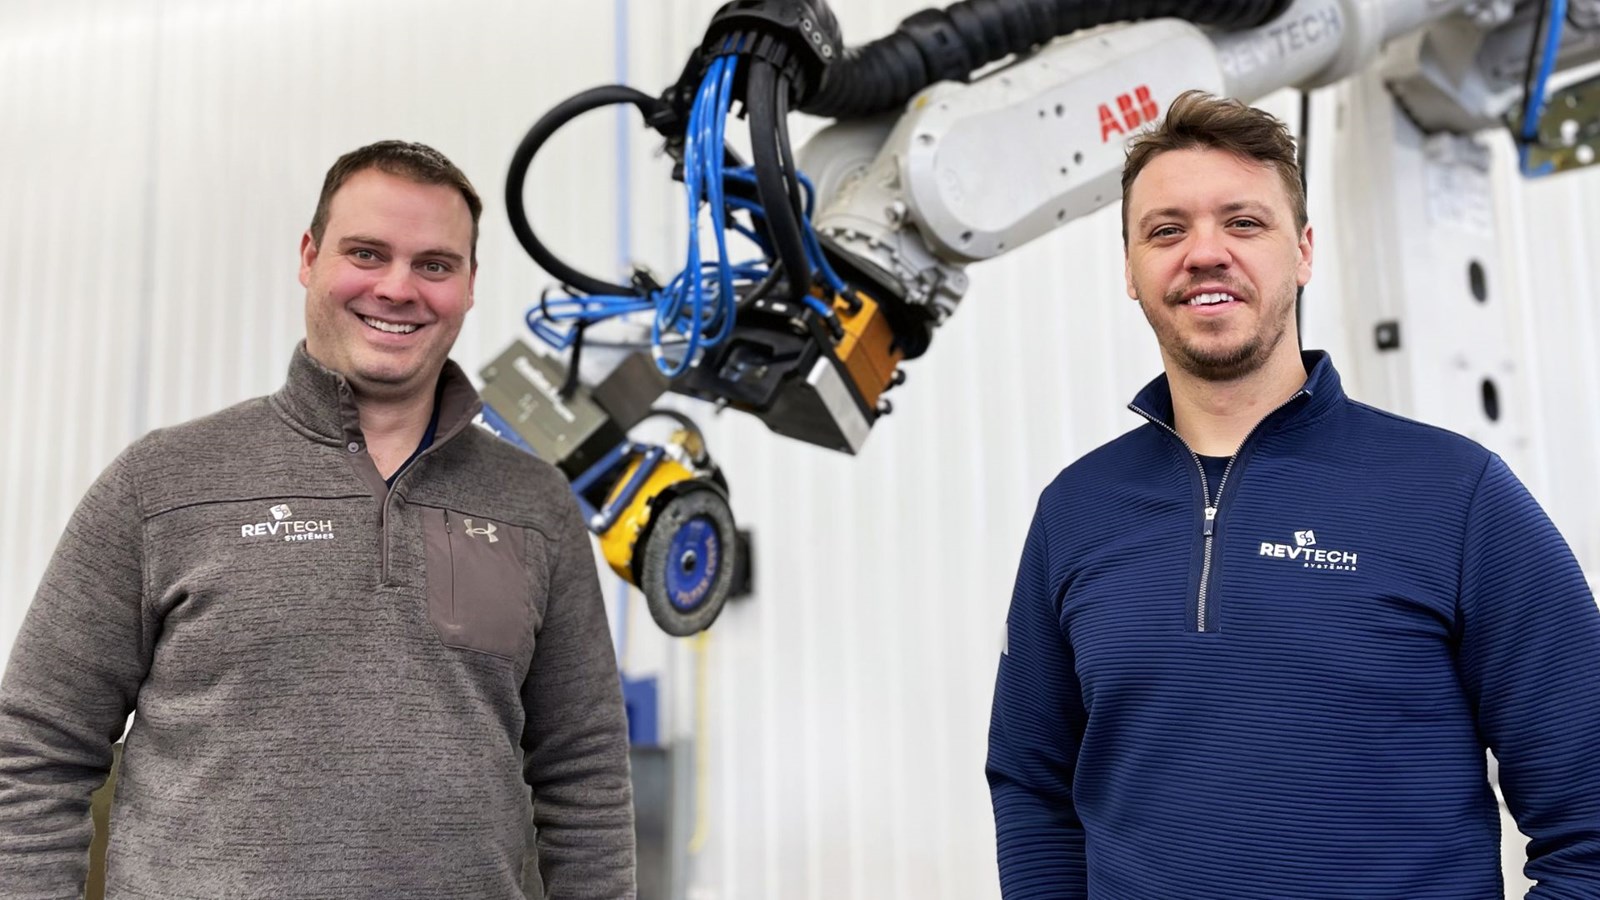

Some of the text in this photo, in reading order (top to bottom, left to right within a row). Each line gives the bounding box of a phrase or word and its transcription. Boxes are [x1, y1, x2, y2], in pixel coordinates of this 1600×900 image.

[1098, 85, 1159, 143] ABB
[241, 520, 333, 538] REVTECH
[1260, 542, 1358, 564] REVTECH
